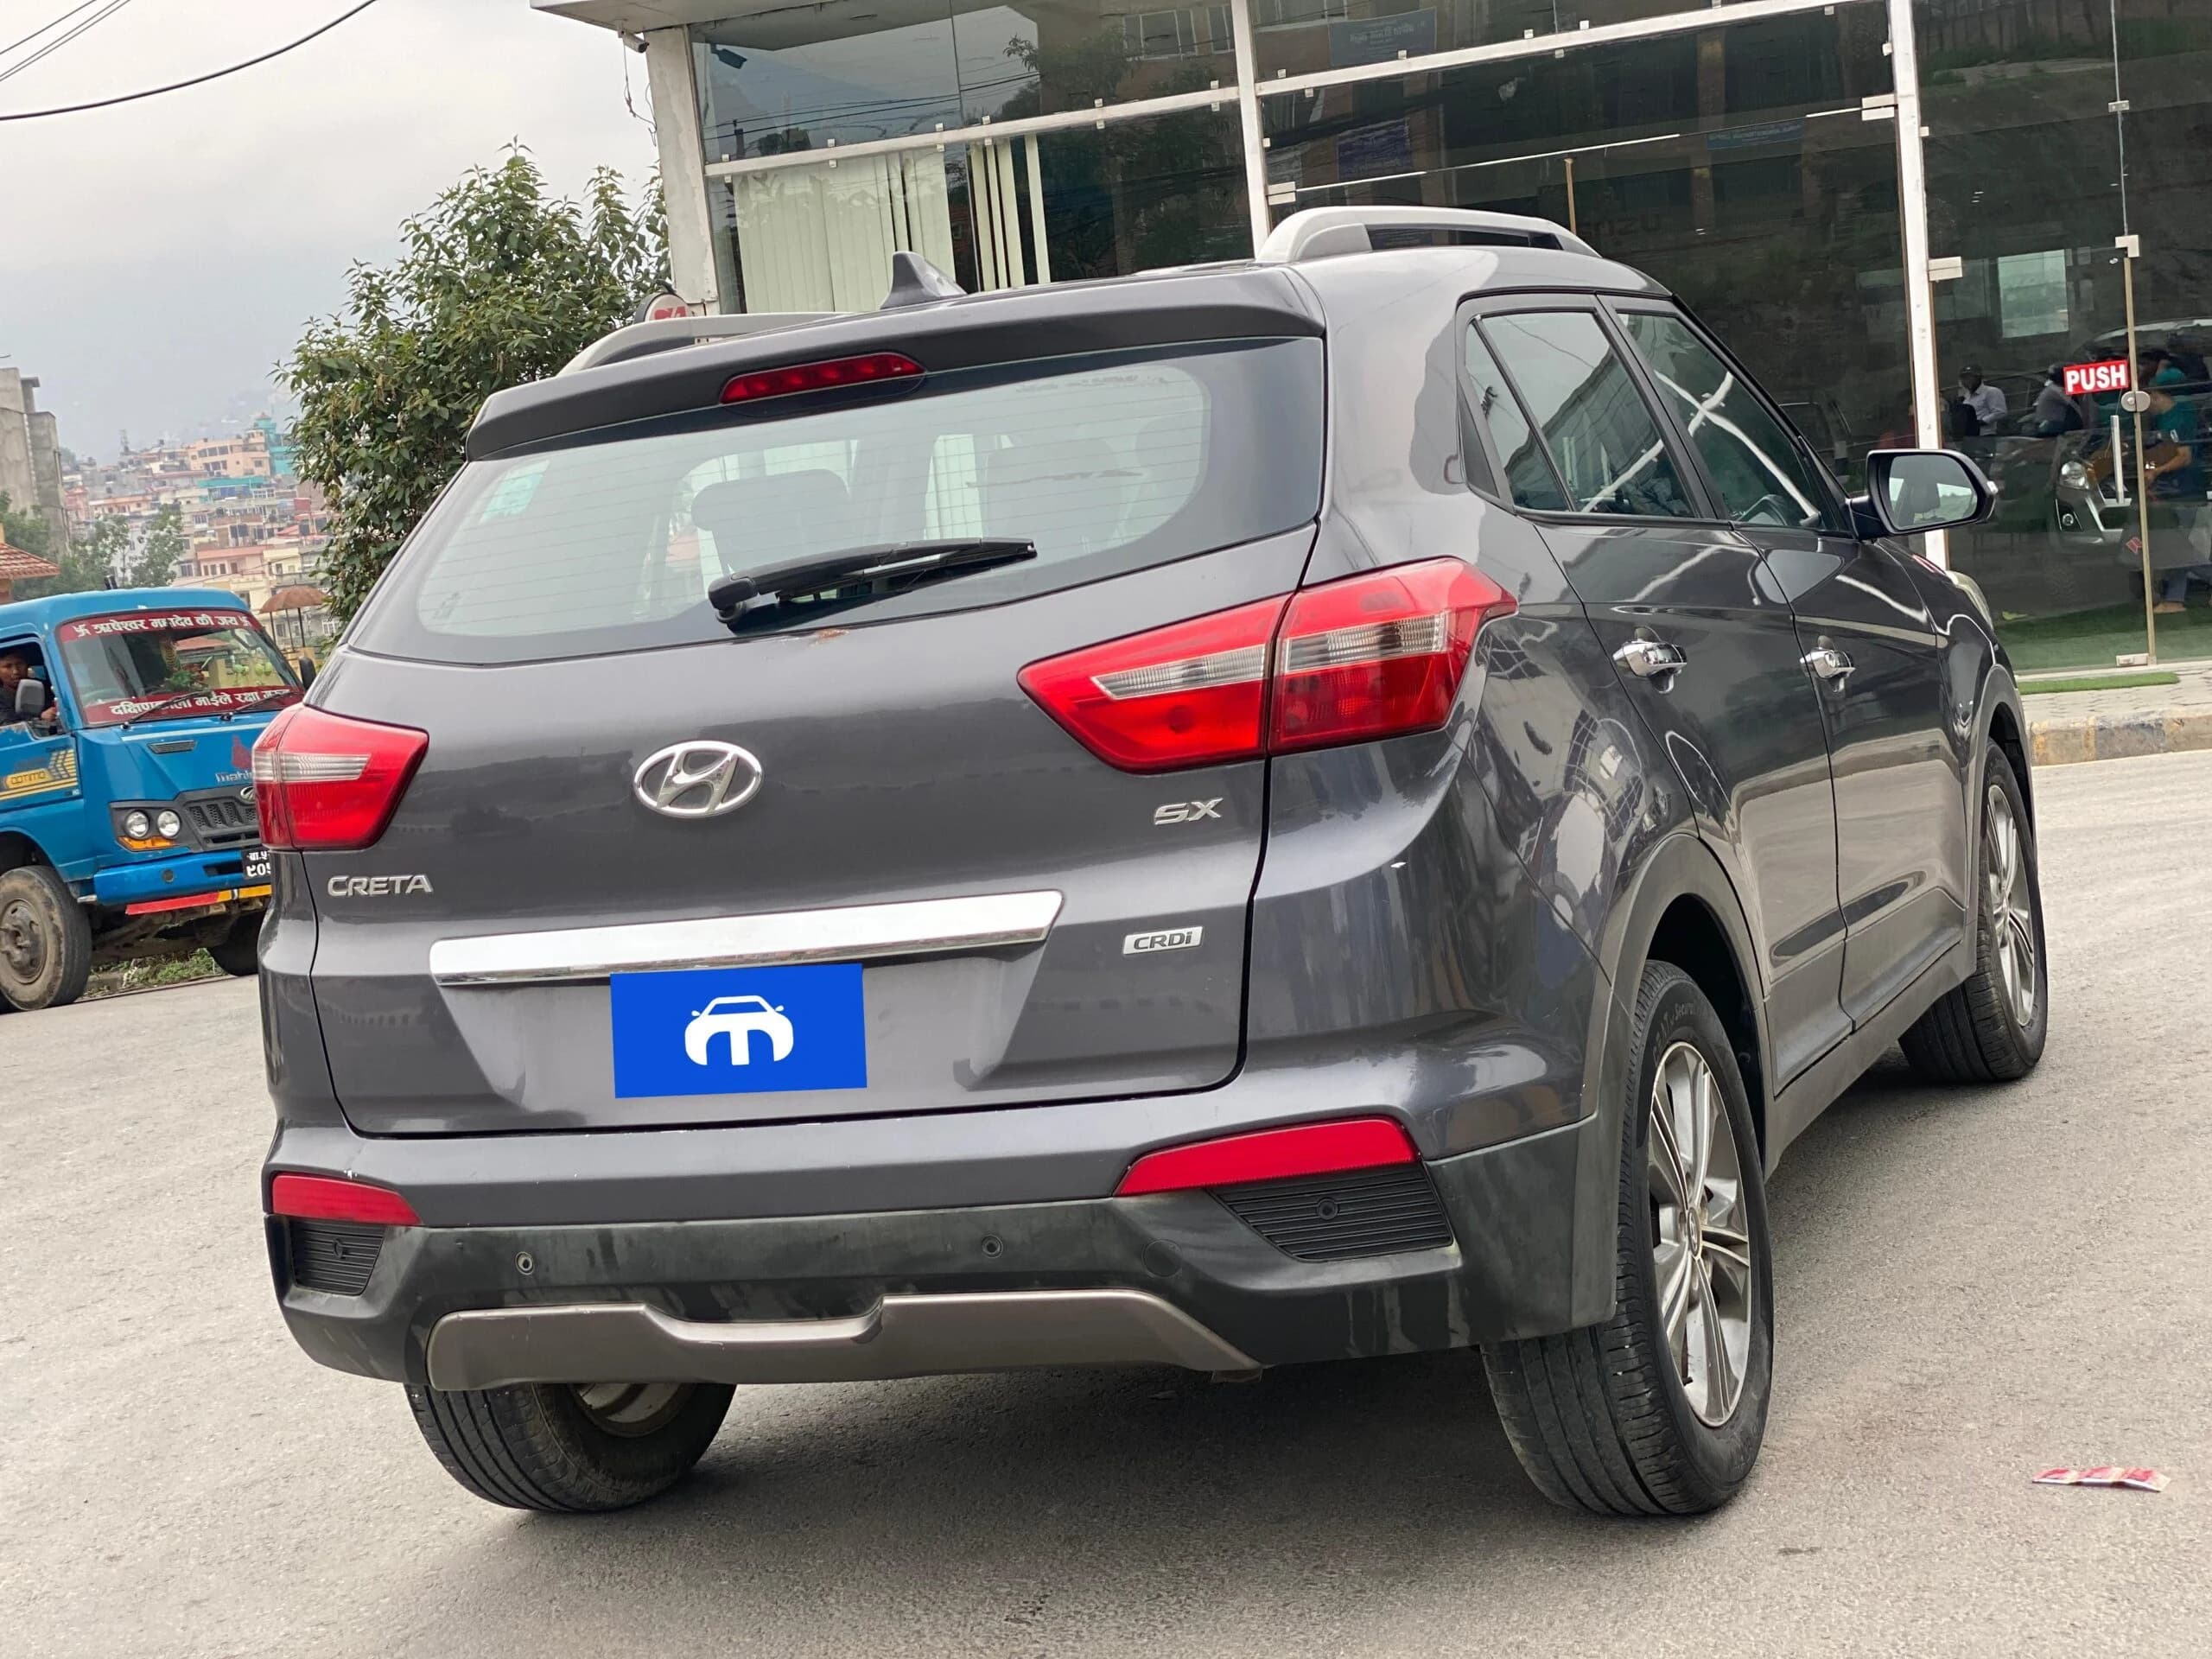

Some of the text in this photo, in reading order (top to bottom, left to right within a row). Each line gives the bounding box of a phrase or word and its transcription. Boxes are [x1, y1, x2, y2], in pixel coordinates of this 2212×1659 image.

[2066, 364, 2126, 392] PUSH
[194, 613, 214, 626] की
[214, 614, 238, 626] जय
[1154, 798, 1224, 825] SX
[327, 874, 433, 896] CRETA
[1134, 931, 1193, 950] CRDi
